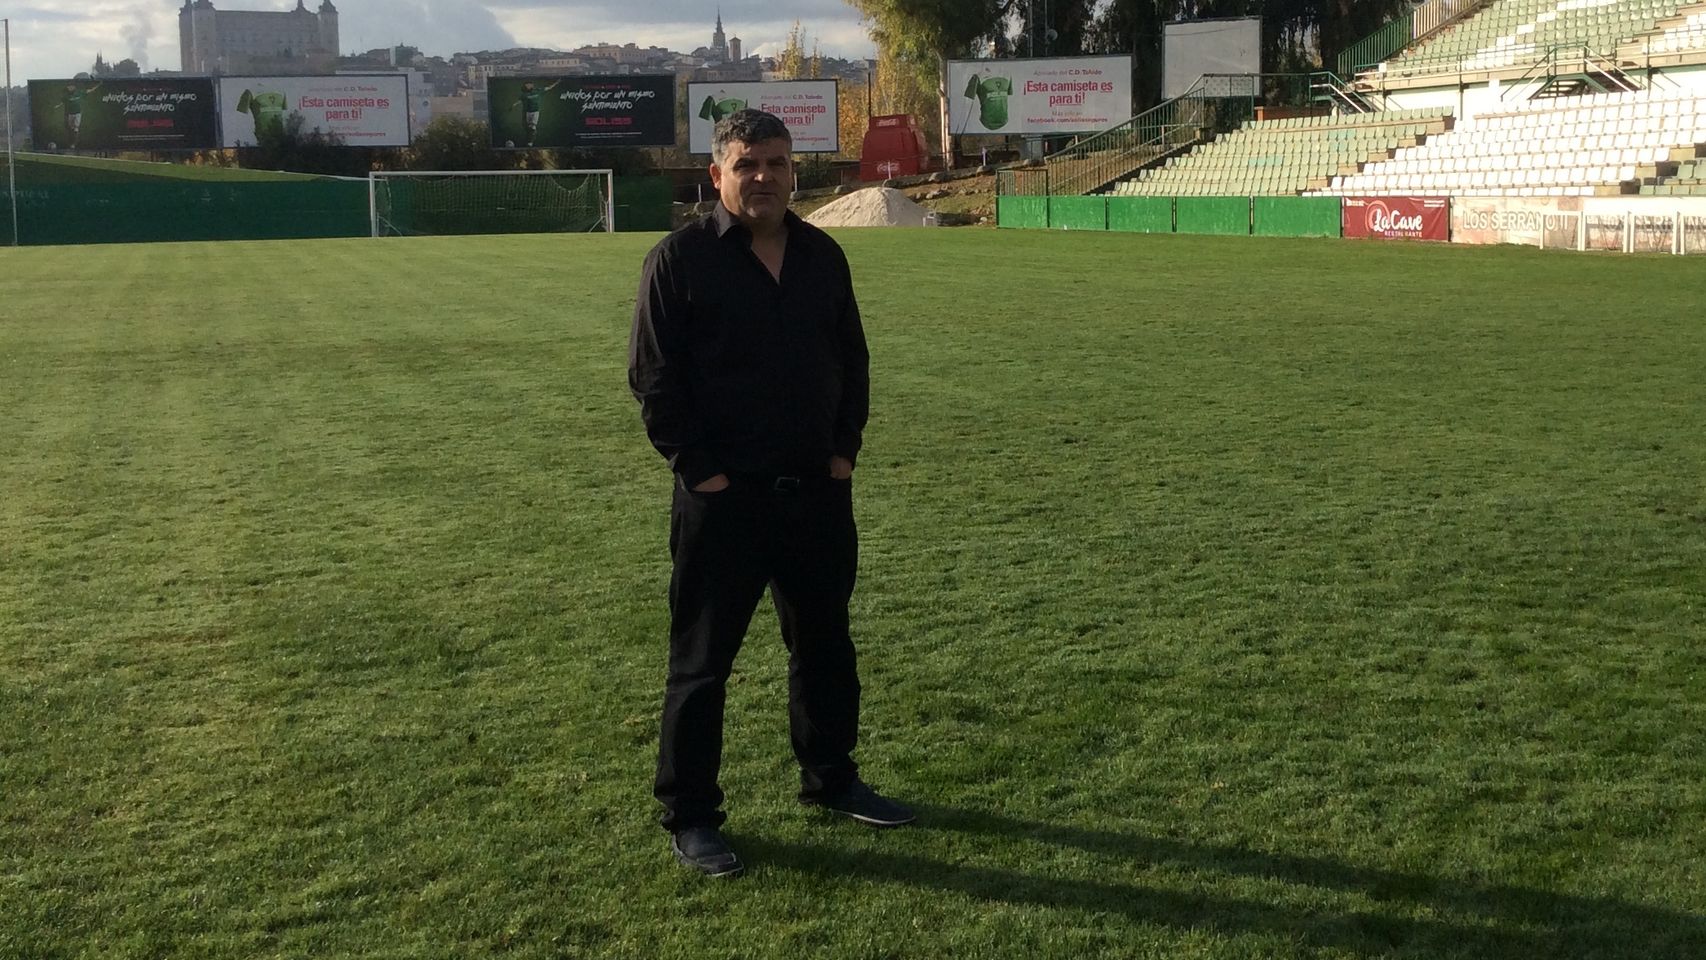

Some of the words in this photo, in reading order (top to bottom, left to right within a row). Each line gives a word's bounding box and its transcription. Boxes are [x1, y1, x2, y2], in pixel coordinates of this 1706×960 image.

[1023, 80, 1049, 95] ¡Esta
[1050, 80, 1098, 92] camiseta
[1100, 82, 1113, 92] es
[298, 96, 325, 111] ¡Esta
[326, 95, 375, 109] camiseta
[376, 98, 390, 107] es
[1049, 94, 1073, 107] para
[1074, 92, 1086, 104] ti!
[325, 109, 350, 122] para
[760, 103, 781, 113] Esta
[782, 103, 826, 114] camiseta
[1463, 210, 1489, 231] LOS
